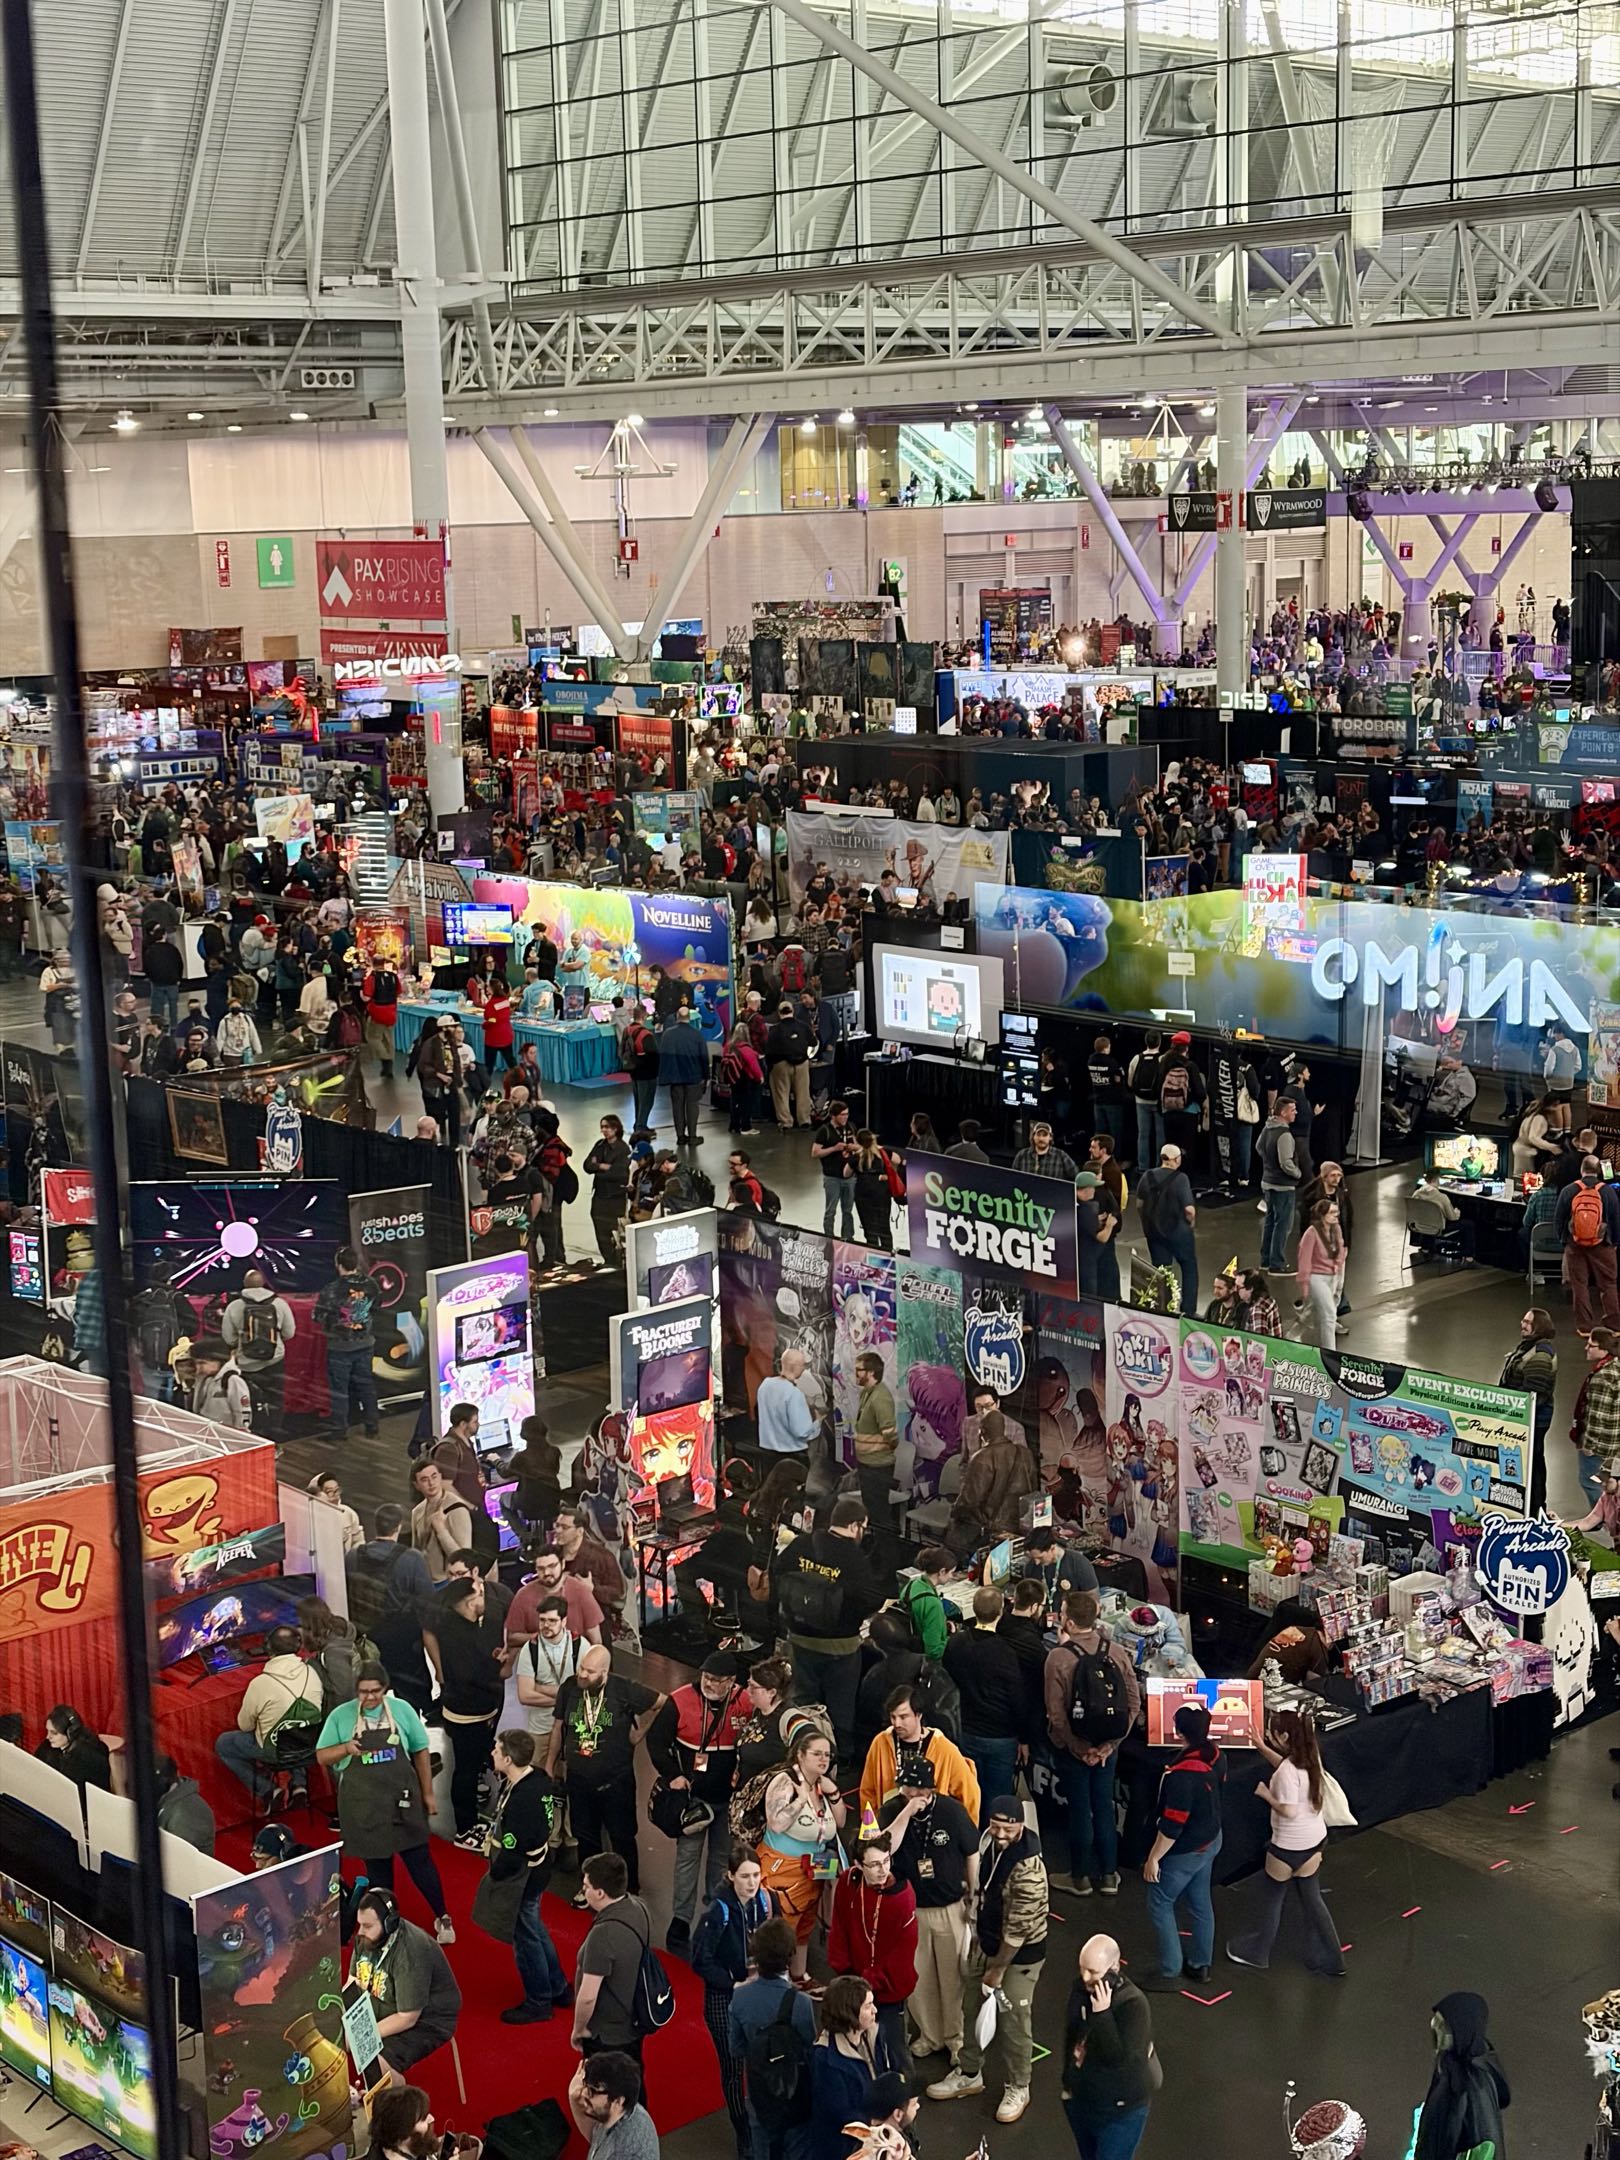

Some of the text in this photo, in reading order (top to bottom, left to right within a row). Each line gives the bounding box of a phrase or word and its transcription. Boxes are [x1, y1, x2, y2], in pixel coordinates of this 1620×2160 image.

[1274, 499, 1322, 511] WYRMWOOD
[354, 558, 440, 583] PAX RISING
[356, 589, 441, 603] SHOWCASE
[330, 643, 376, 655] PRESENTED BY
[1025, 690, 1059, 703] PALACE
[1332, 718, 1407, 739] TOROBAN
[814, 833, 884, 850] GALLIPOLI
[642, 903, 712, 929] NOVELLINE
[1217, 1059, 1234, 1118] WALKER
[276, 1148, 290, 1164] PIN
[924, 1171, 1055, 1238] Serenity
[925, 1209, 1057, 1278] FORGE
[782, 1252, 829, 1277] PRINCESS
[627, 1316, 702, 1345] FRACTURED
[981, 1327, 1019, 1344] Arcade
[639, 1331, 693, 1360] BLOOMS
[983, 1367, 1007, 1384] PIN
[1289, 1364, 1316, 1381] SLAY
[1341, 1356, 1384, 1375] Serenity
[1274, 1372, 1332, 1399] PRINCESS
[1339, 1366, 1385, 1388] FORGE
[1408, 1375, 1527, 1409] EVENT EXCLUSIVE
[1410, 1388, 1440, 1401] Physical
[1350, 1491, 1408, 1515] UMURANGI
[1484, 1514, 1533, 1541] Pinny
[1505, 1531, 1567, 1554] Arcade
[216, 1543, 257, 1571] KEEPER
[1503, 1573, 1541, 1586] AUTHORIZED
[1502, 1580, 1540, 1602] PIN
[1502, 1597, 1538, 1610] DEALER
